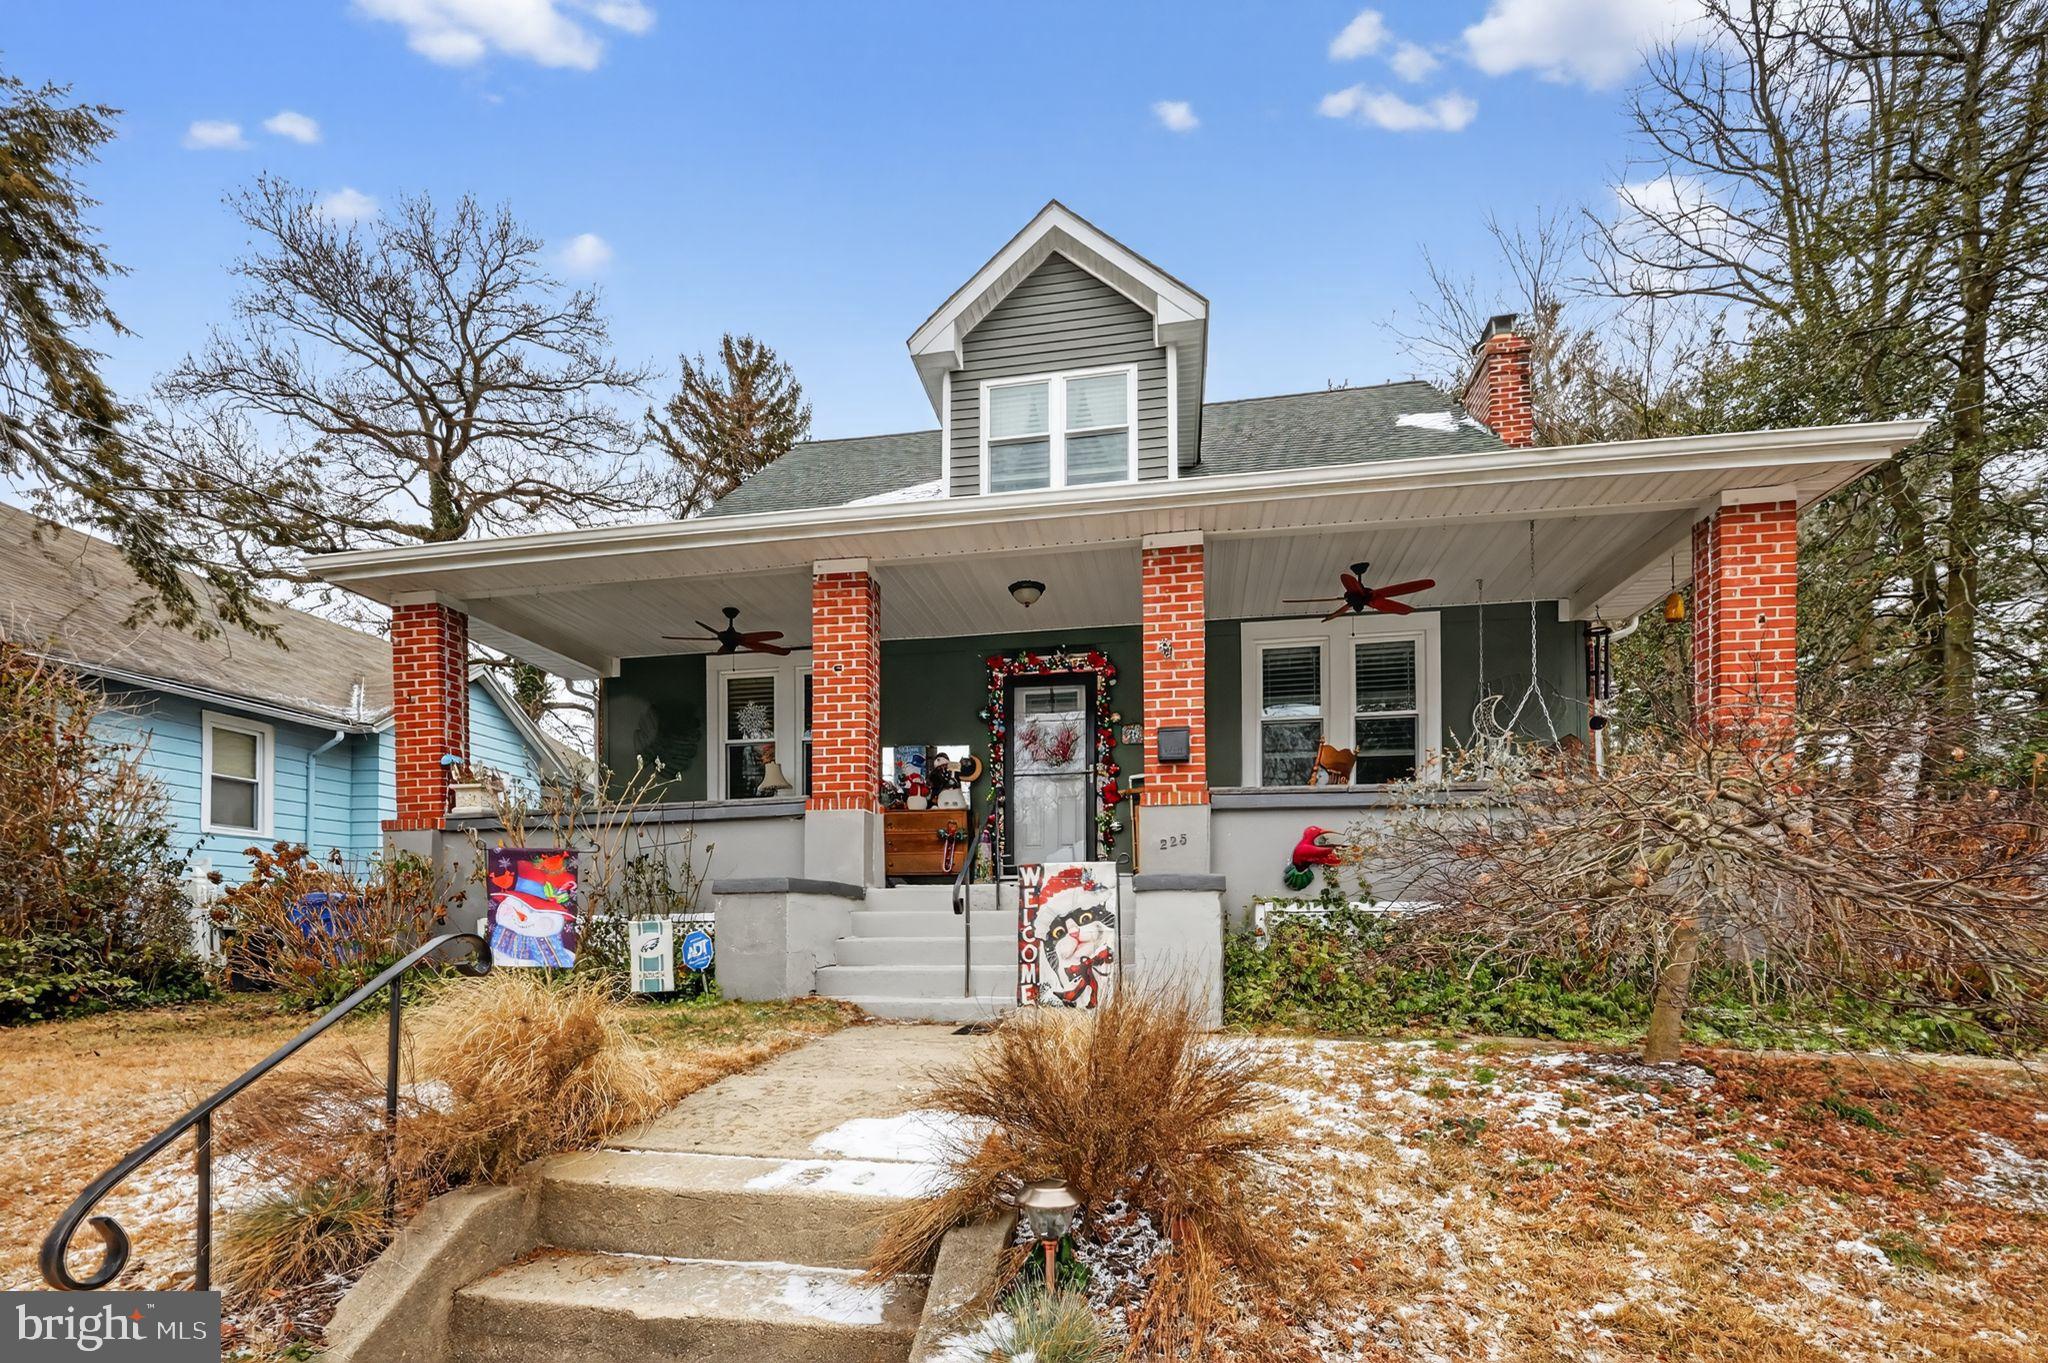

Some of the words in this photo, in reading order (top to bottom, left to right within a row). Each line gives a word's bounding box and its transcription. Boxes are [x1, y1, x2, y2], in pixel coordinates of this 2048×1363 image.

[1159, 833, 1188, 850] 225
[1019, 866, 1042, 1006] WELCOME
[687, 939, 709, 960] ADT
